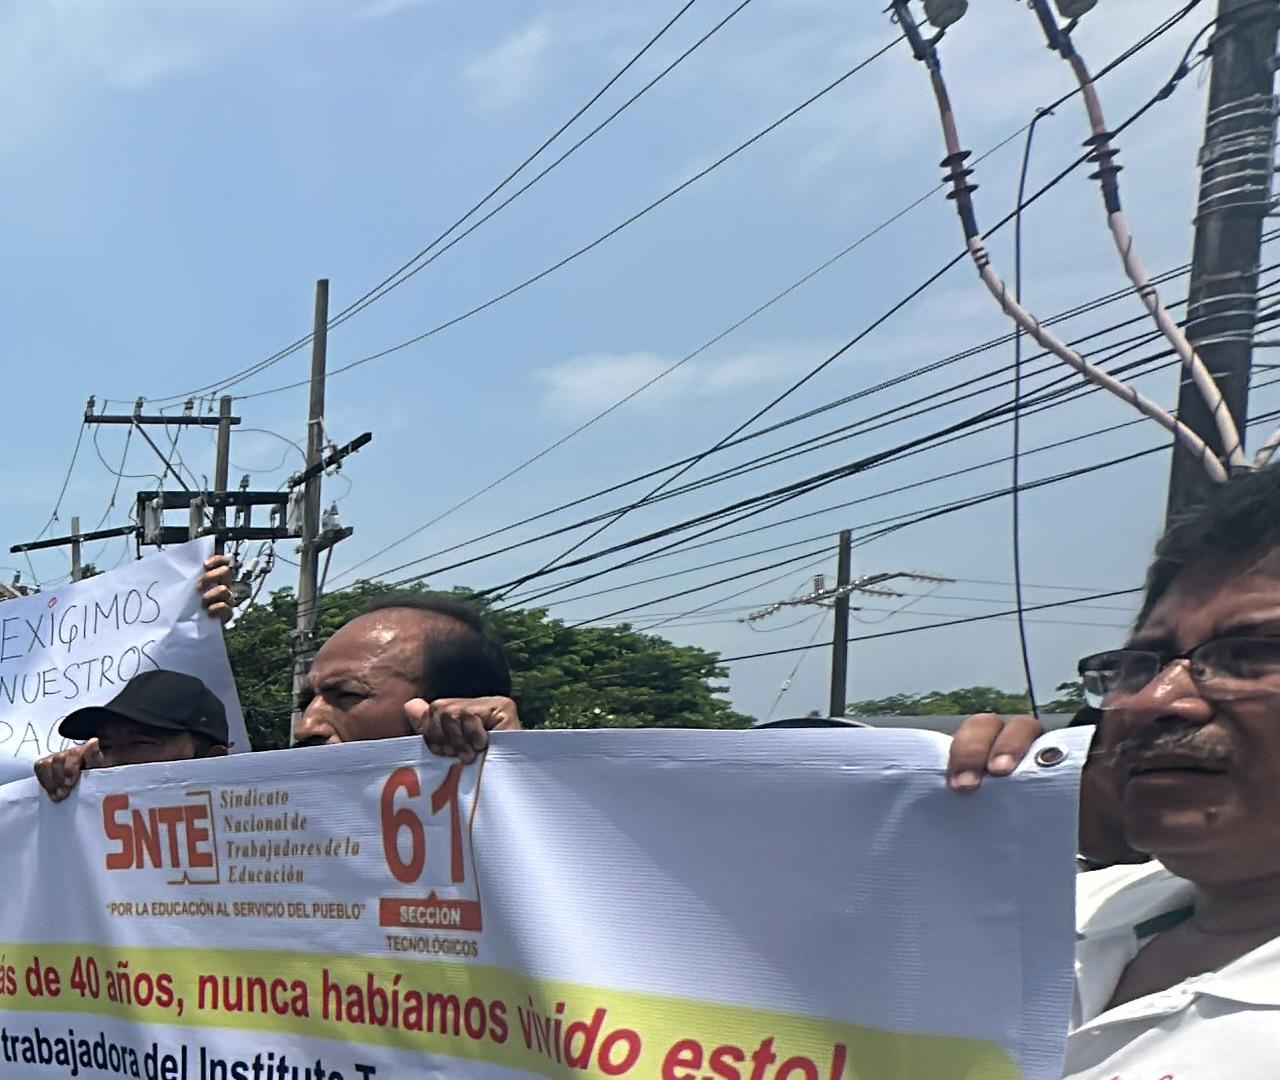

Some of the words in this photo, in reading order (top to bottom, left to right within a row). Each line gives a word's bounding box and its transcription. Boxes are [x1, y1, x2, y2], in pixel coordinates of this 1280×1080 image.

[220, 790, 289, 808] Sindicato
[102, 792, 214, 870] SNTE
[223, 813, 287, 832] Nacional
[290, 815, 308, 831] de
[381, 763, 465, 884] 61
[227, 839, 323, 859] Trabajadores
[323, 838, 342, 856] de
[345, 838, 360, 856] la
[227, 864, 305, 884] Educación
[136, 903, 149, 915] LA
[151, 899, 214, 916] EDUCACIÓN
[216, 903, 231, 917] AL
[233, 903, 285, 918] SERVICIO
[288, 904, 310, 918] DEL
[26, 956, 61, 997] de
[71, 956, 100, 999] 40
[107, 961, 184, 1016] años,
[198, 973, 309, 1018] nunca
[323, 969, 507, 1044] habíamos
[519, 995, 642, 1076] vivido
[2, 1027, 139, 1078] trabajadora
